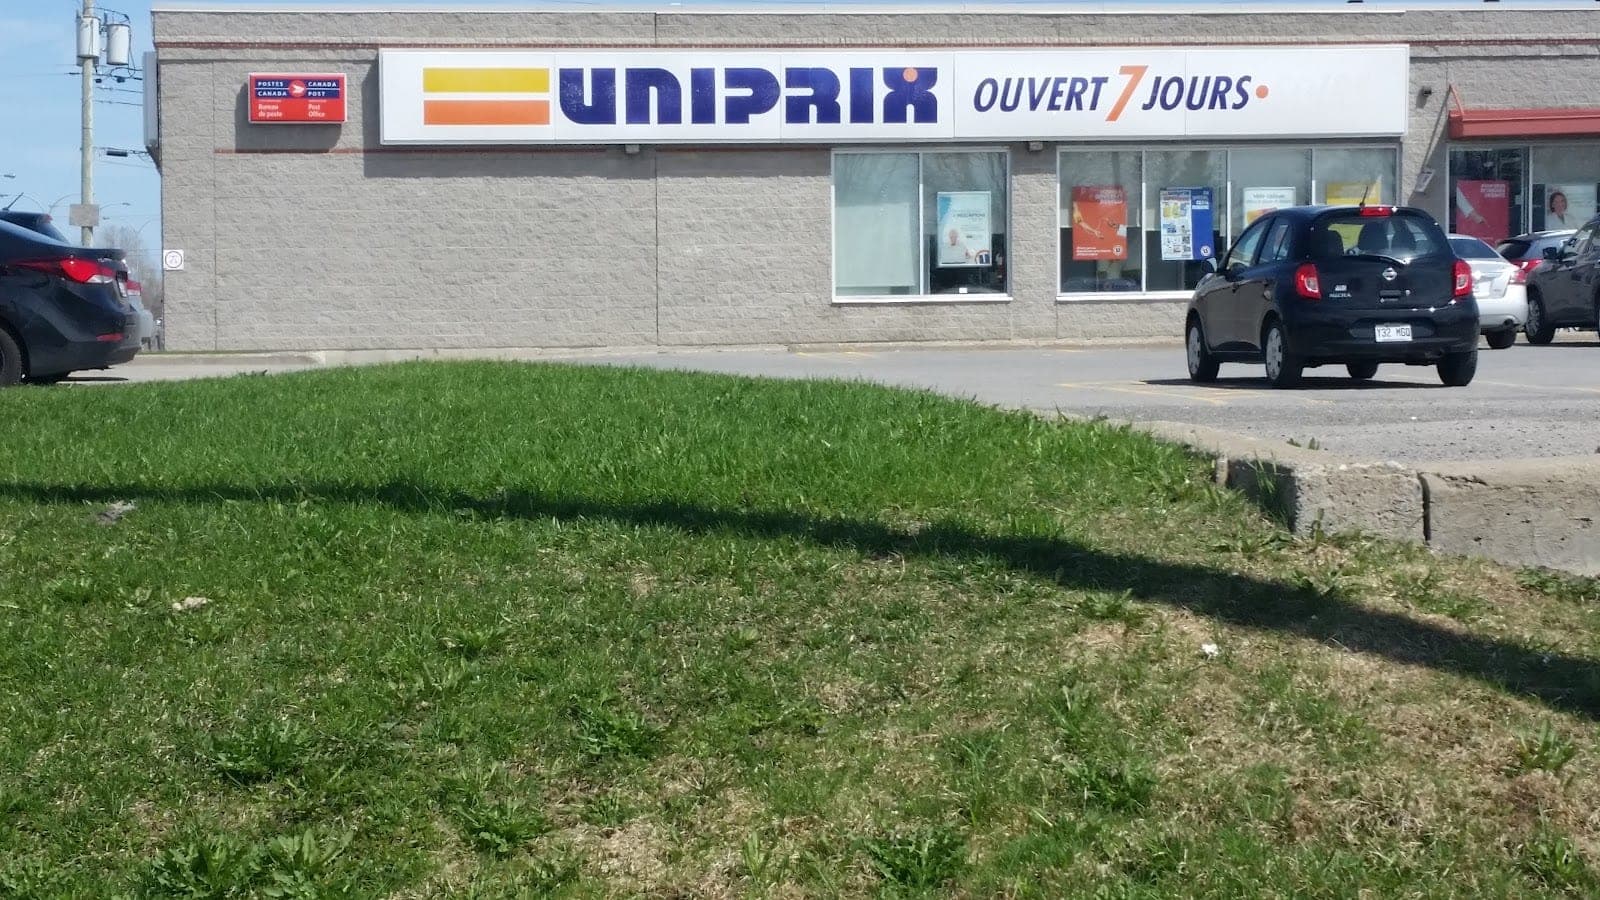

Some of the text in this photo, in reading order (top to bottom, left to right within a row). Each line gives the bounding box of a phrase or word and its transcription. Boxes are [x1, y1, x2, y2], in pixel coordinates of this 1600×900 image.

[559, 67, 938, 125] UNIPRIX
[973, 65, 1252, 122] OUVERT 7 JOURS
